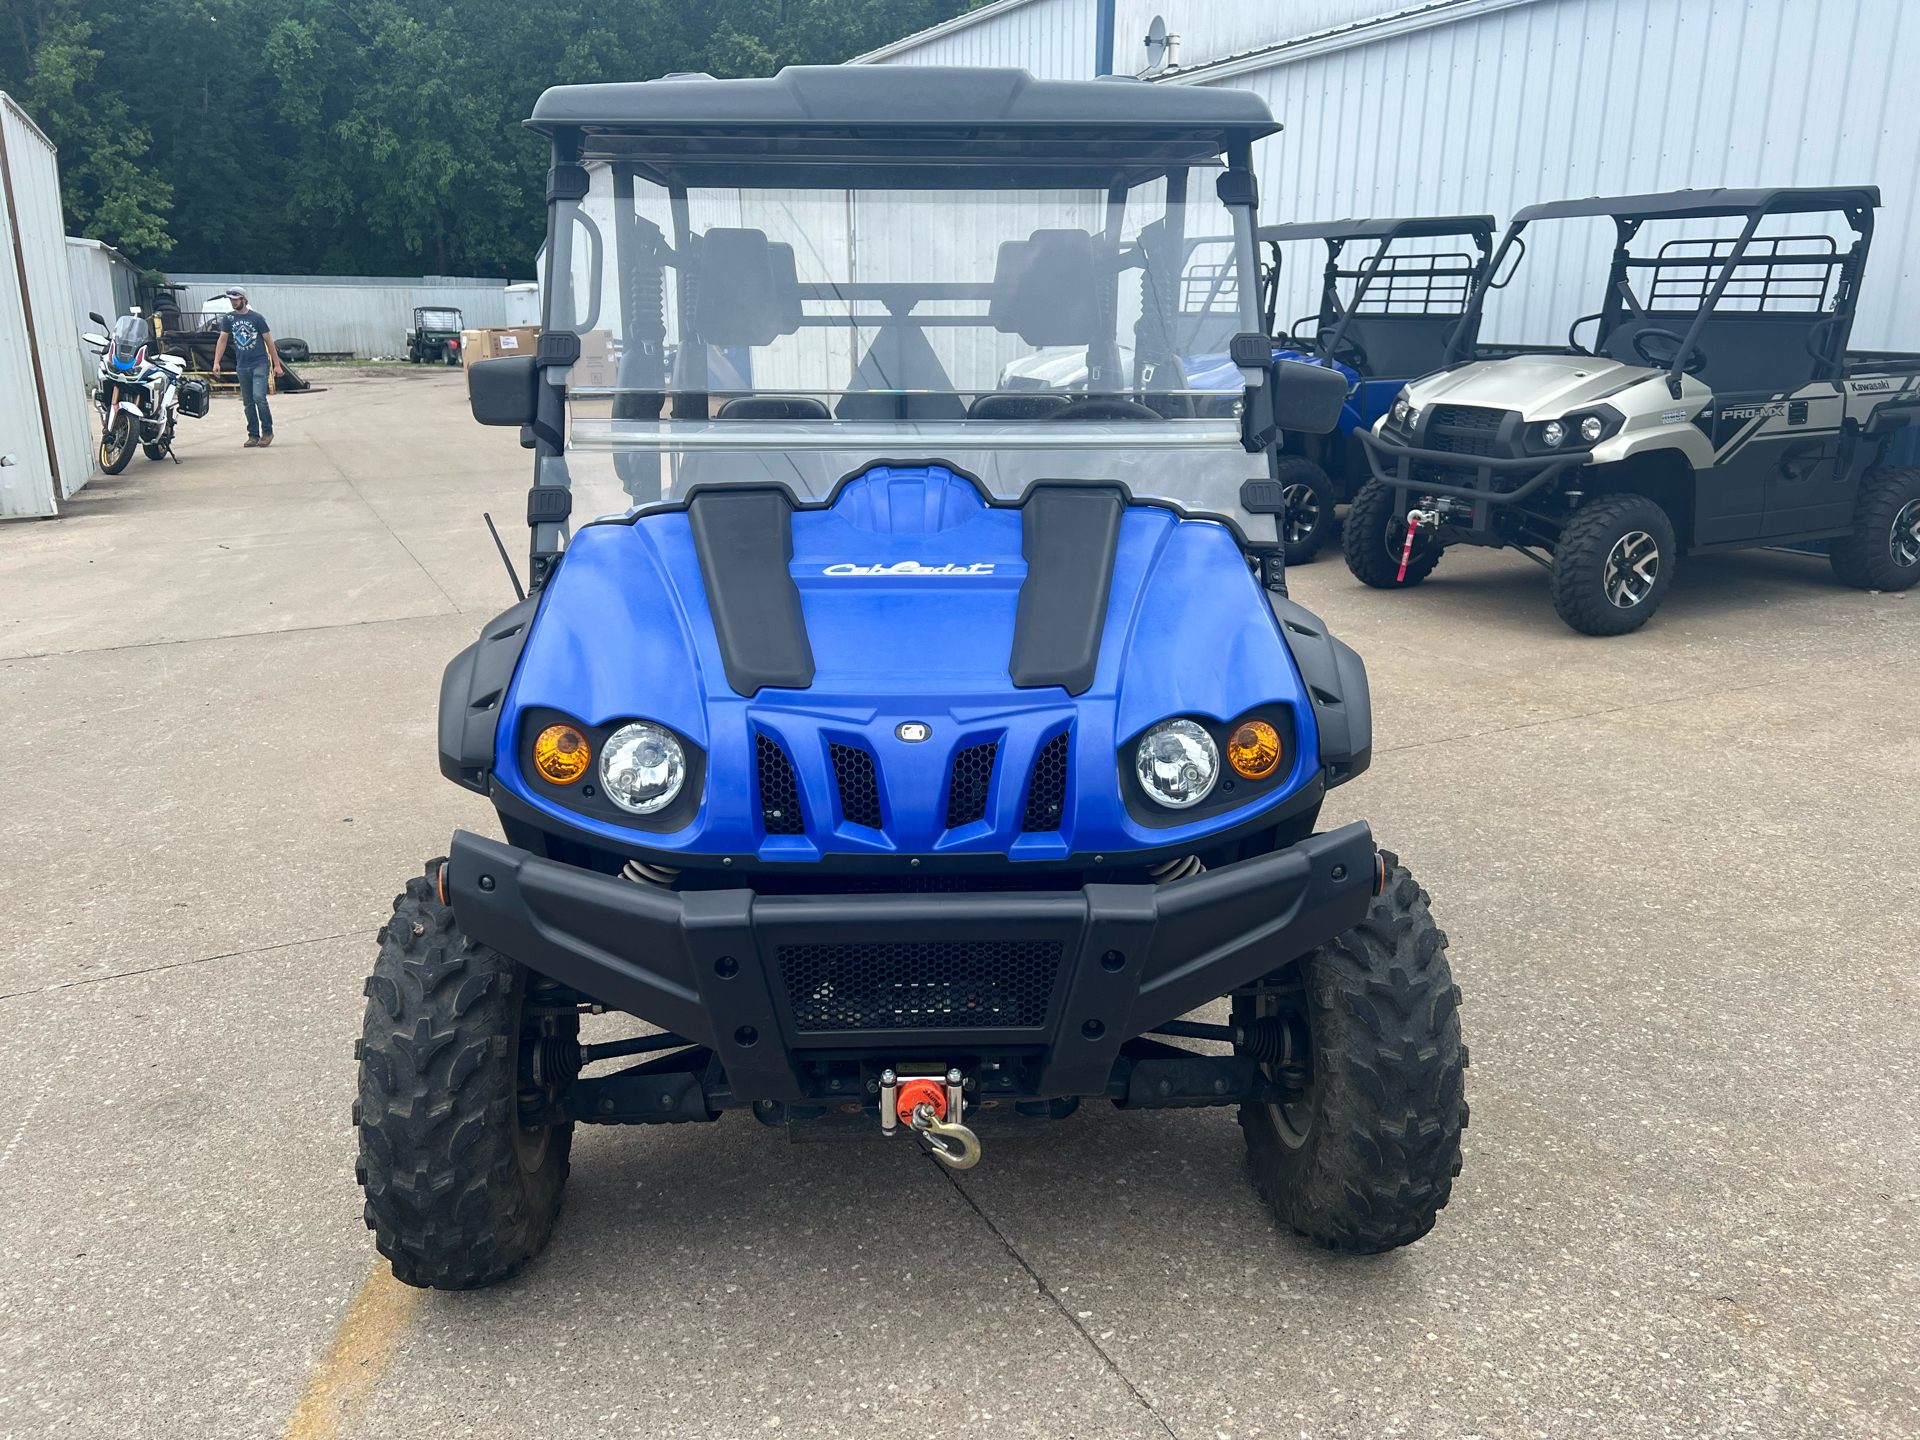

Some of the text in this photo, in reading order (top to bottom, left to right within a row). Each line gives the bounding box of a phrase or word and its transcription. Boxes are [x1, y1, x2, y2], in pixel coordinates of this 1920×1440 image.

[1850, 380, 1890, 391] Kawasaki
[1721, 405, 1785, 420] PRO-MX
[884, 560, 995, 576] Cadet
